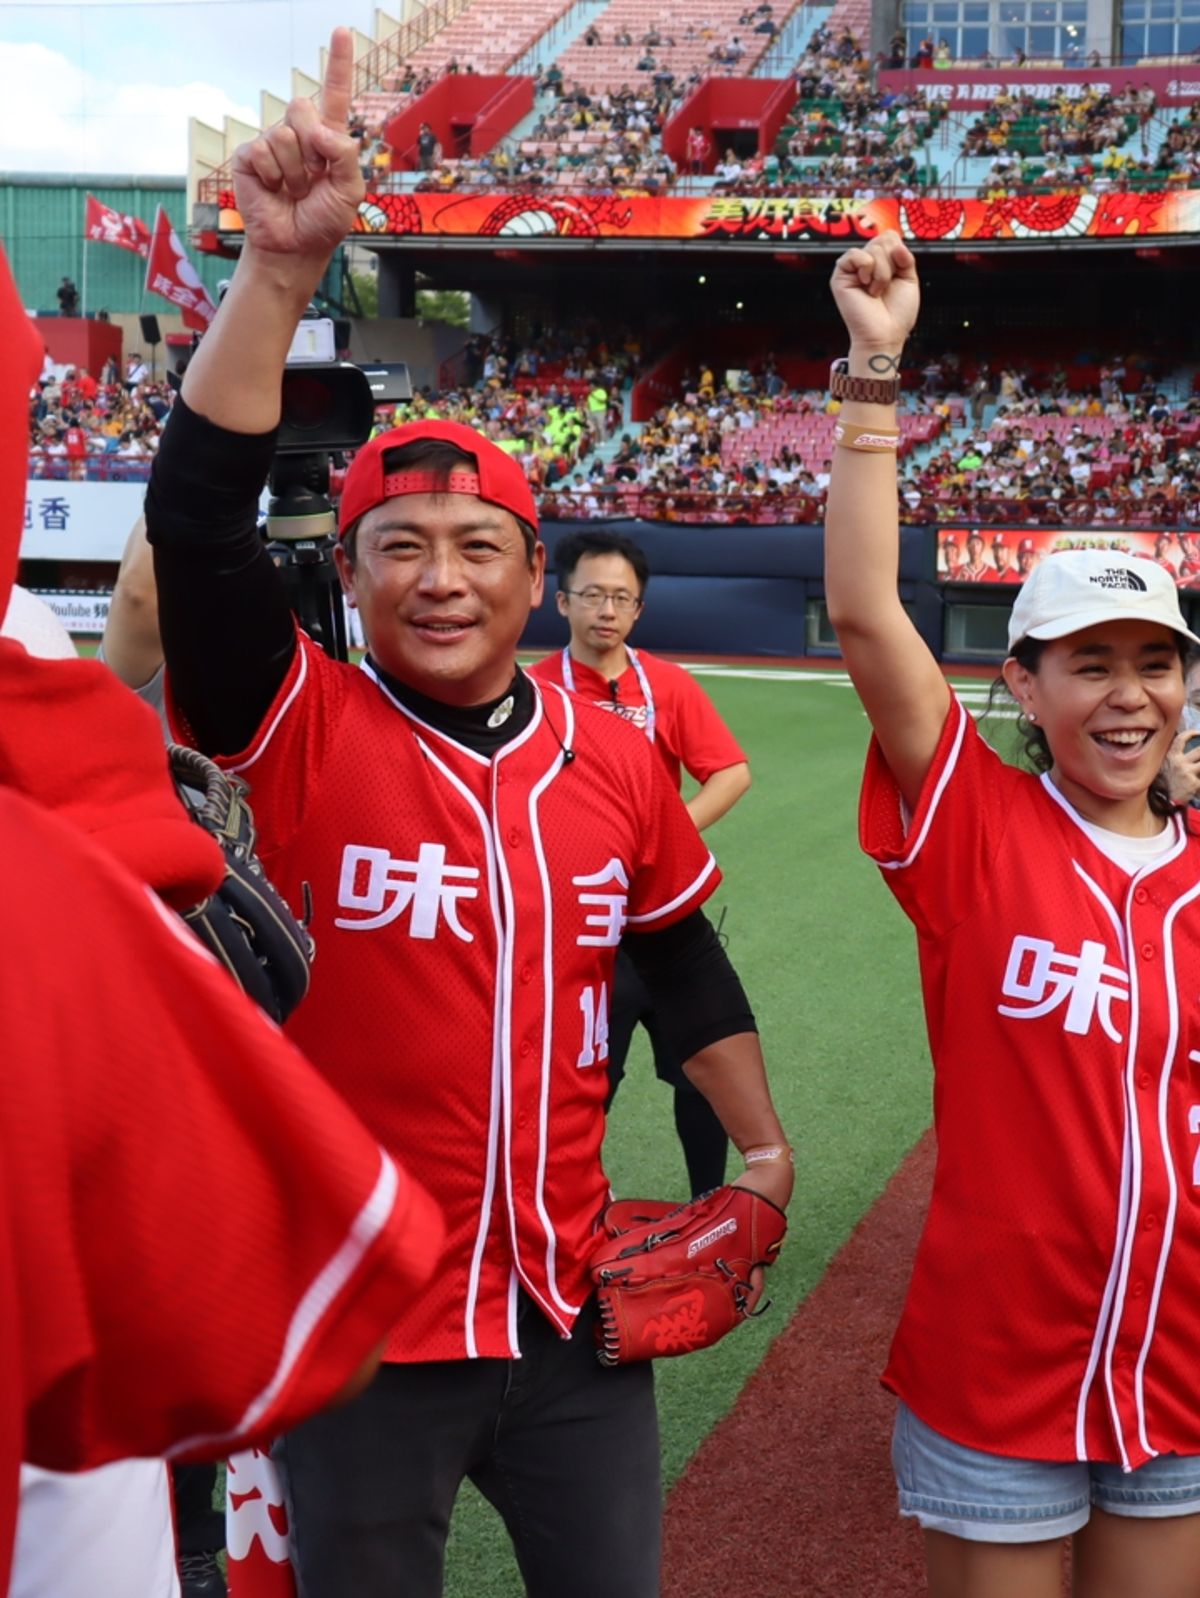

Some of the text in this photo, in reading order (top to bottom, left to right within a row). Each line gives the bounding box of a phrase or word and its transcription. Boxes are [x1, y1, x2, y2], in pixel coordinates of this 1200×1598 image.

[1089, 575, 1128, 583] NORTH
[1105, 568, 1125, 576] THE
[334, 842, 629, 946] 味 全
[997, 934, 1130, 1044] 味
